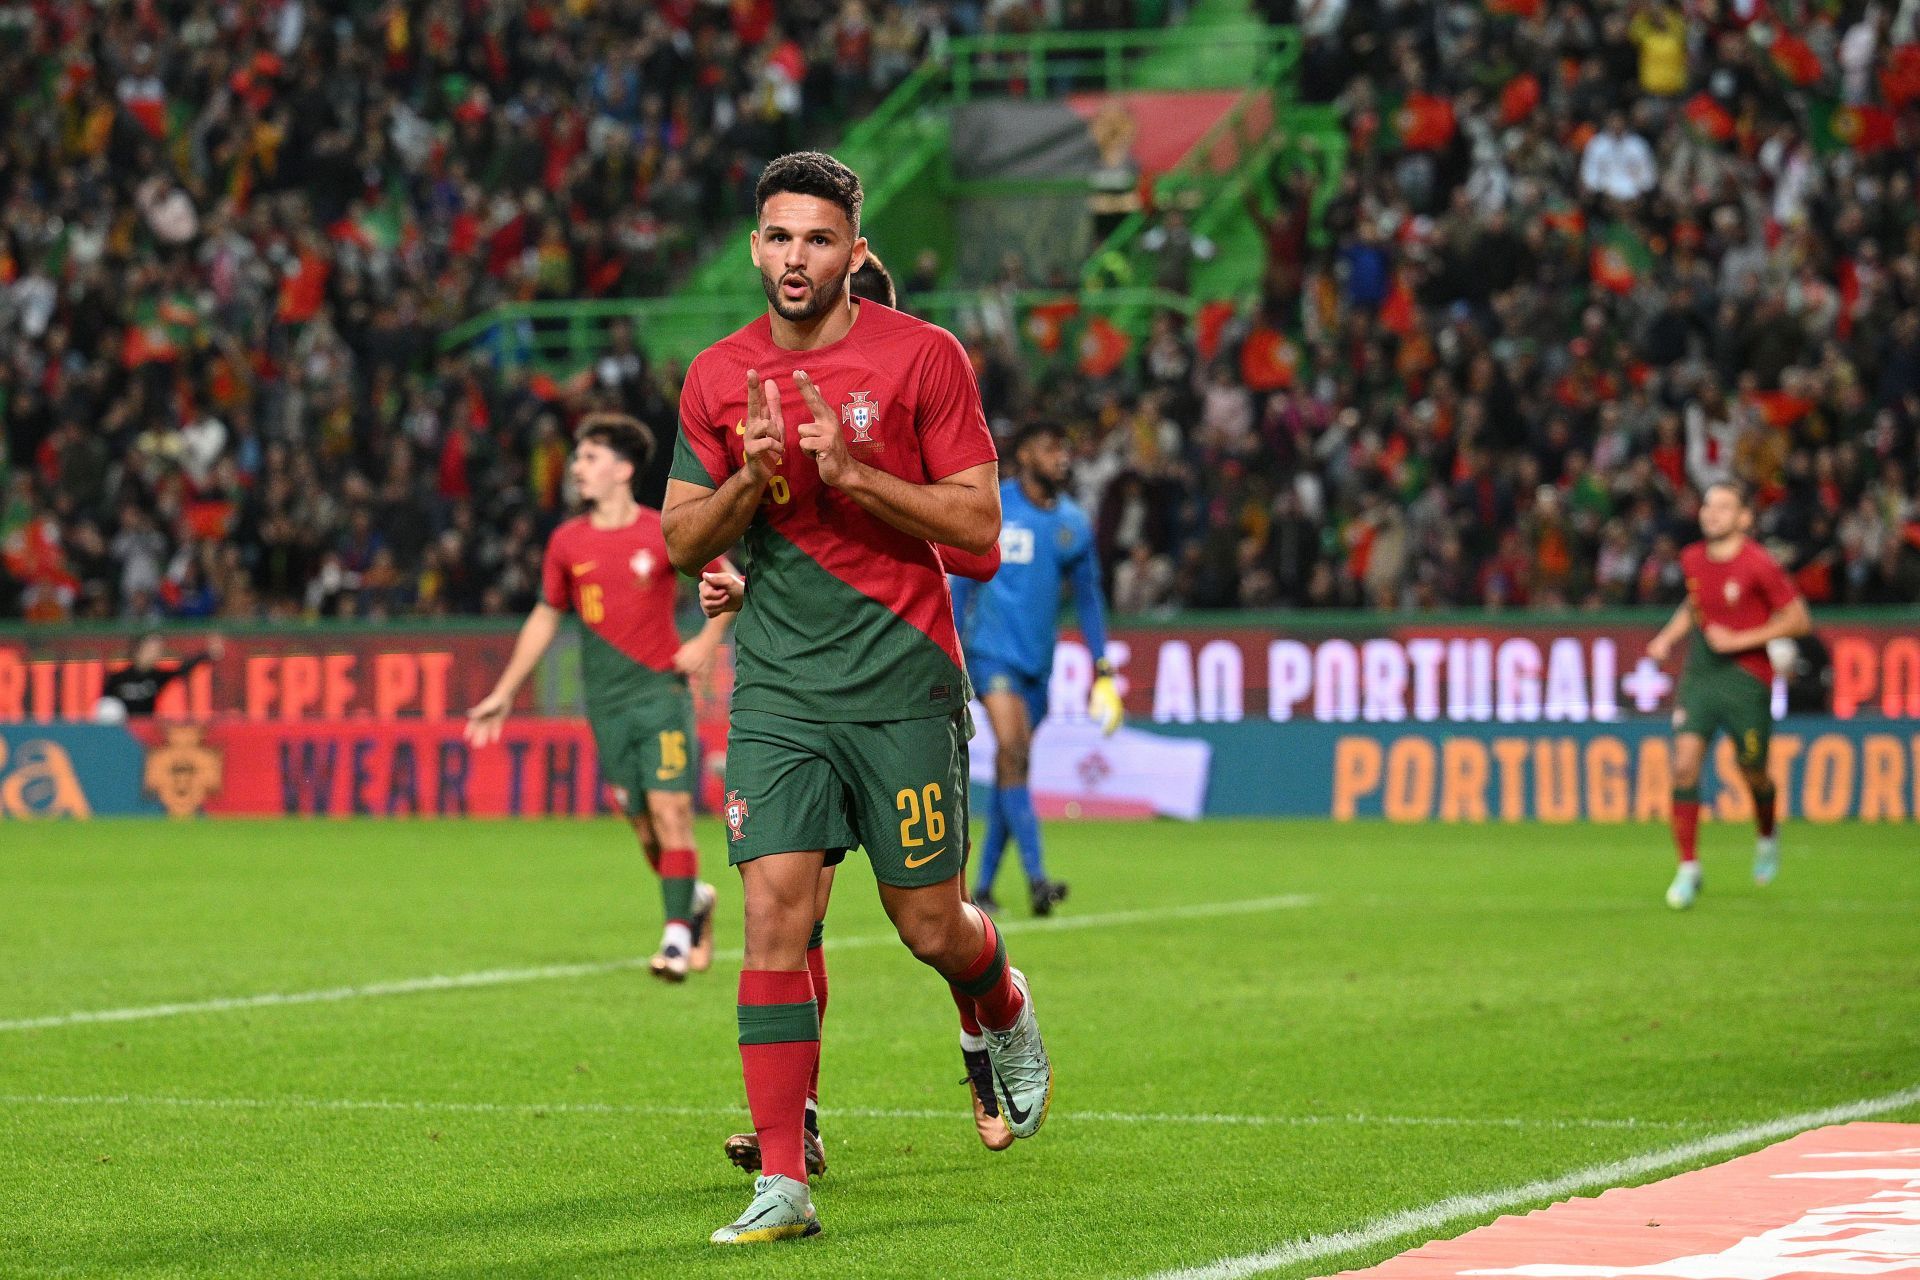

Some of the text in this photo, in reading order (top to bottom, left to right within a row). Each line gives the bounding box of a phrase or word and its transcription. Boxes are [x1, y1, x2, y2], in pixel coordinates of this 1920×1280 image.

[1152, 639, 1244, 724] AO
[279, 737, 470, 819] WEAR
[896, 782, 946, 848] 26
